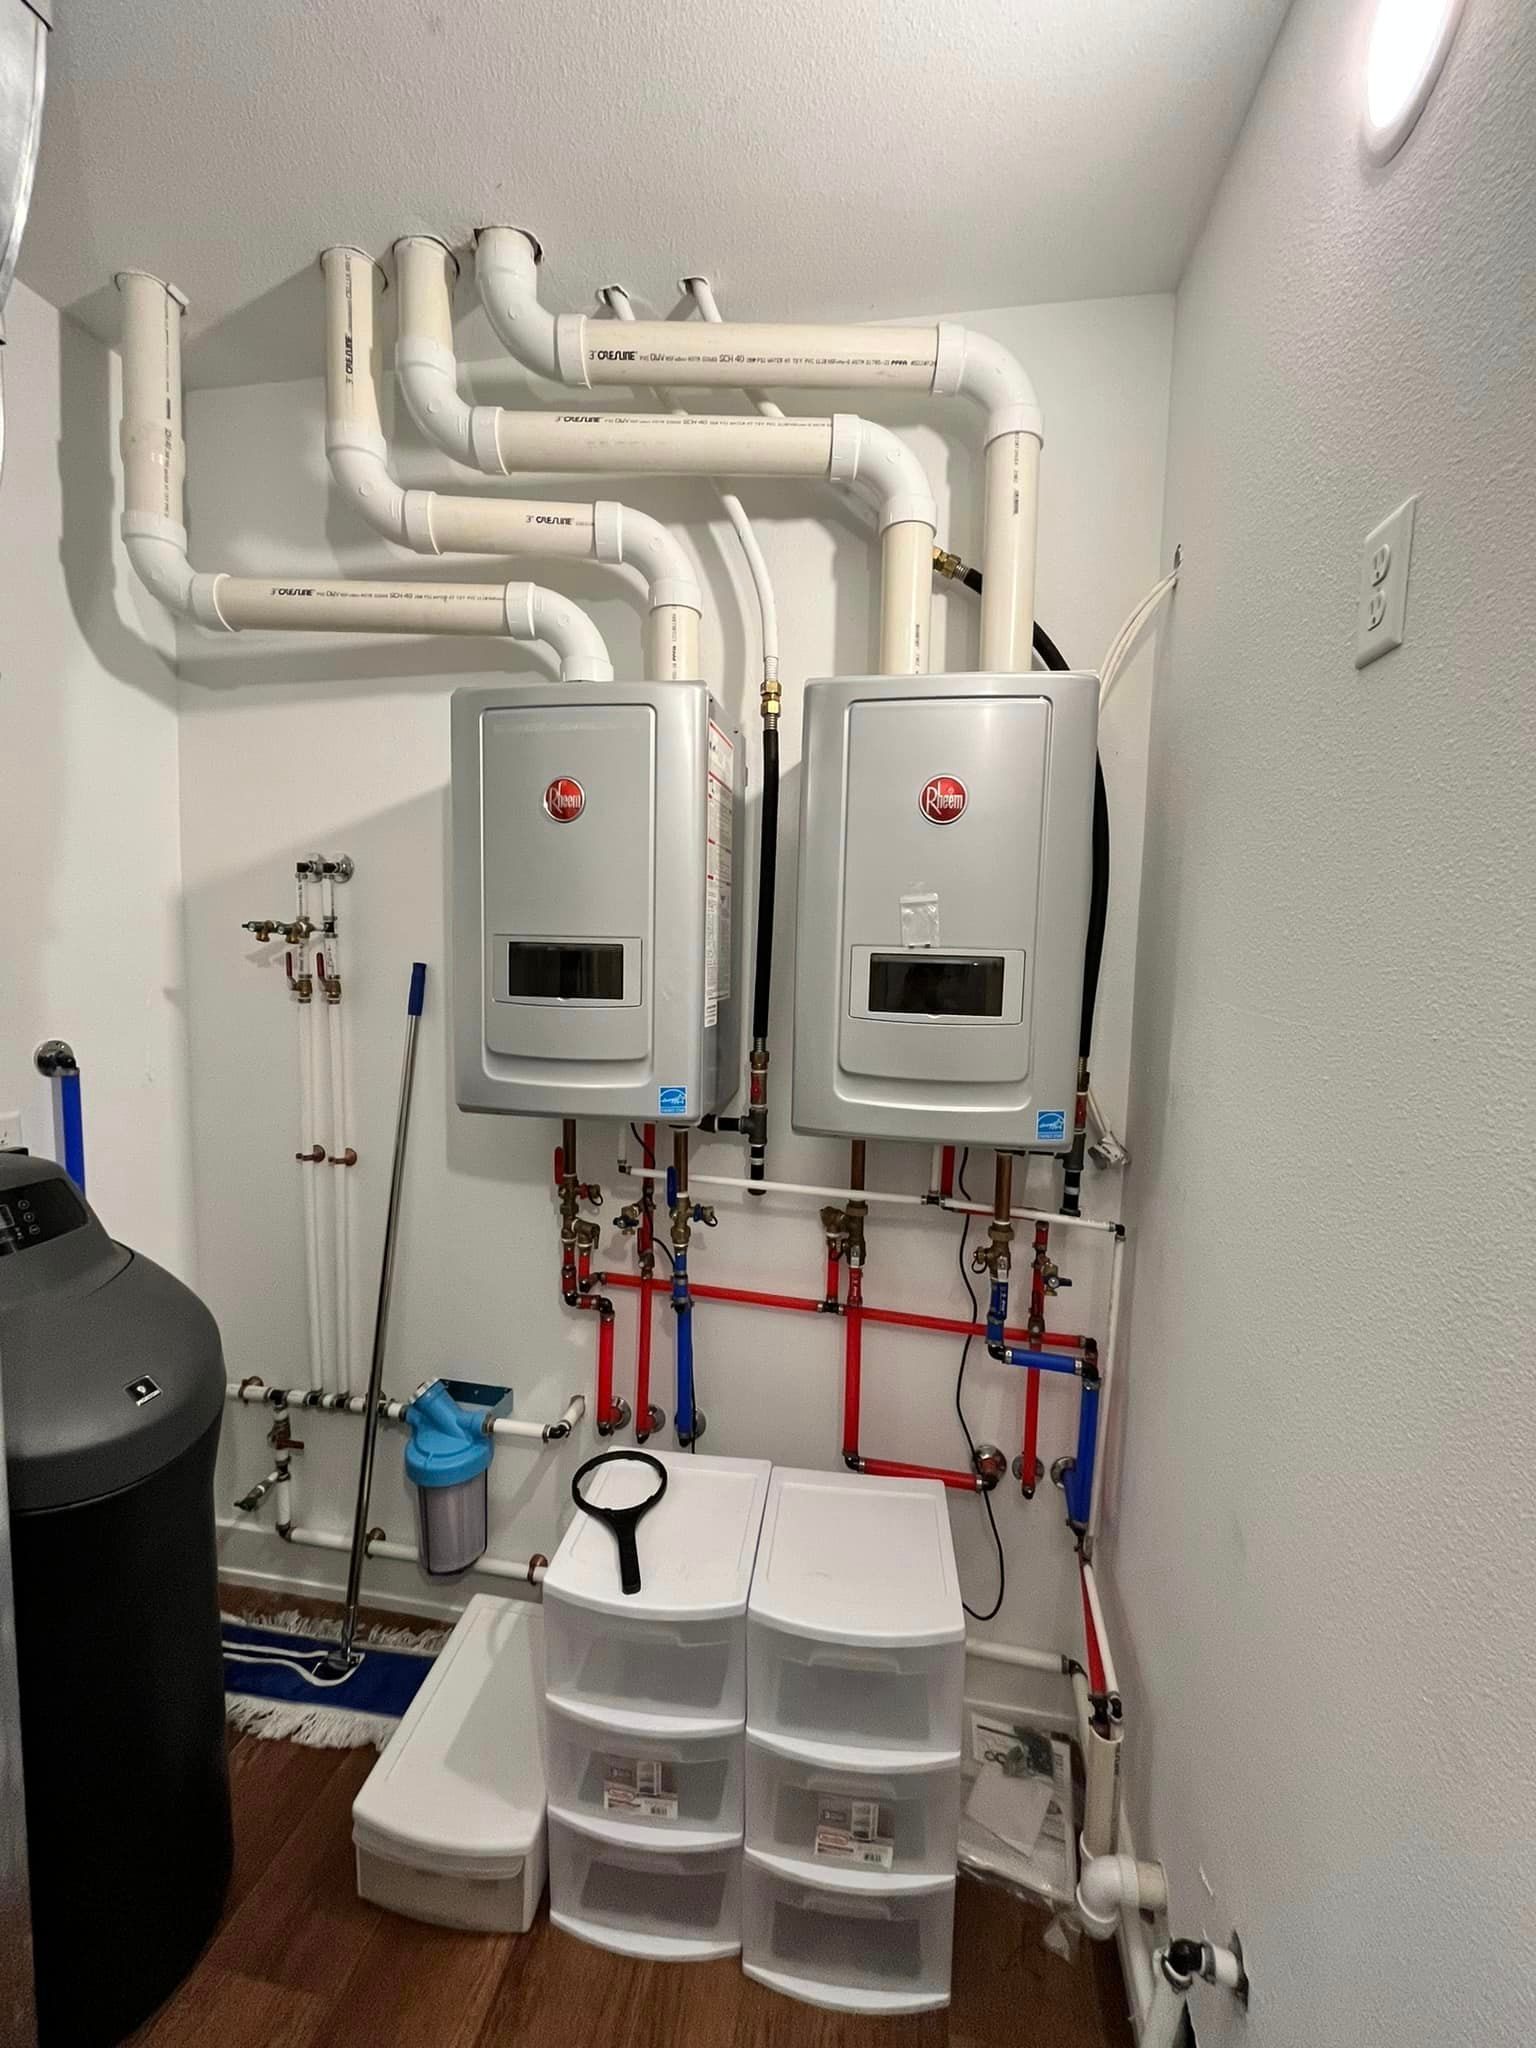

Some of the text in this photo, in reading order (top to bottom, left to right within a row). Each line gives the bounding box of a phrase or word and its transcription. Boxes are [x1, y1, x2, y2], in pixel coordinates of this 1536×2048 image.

[597, 350, 636, 361] CRESLINE
[549, 781, 581, 813] Rheem
[926, 780, 963, 815] Rheem
